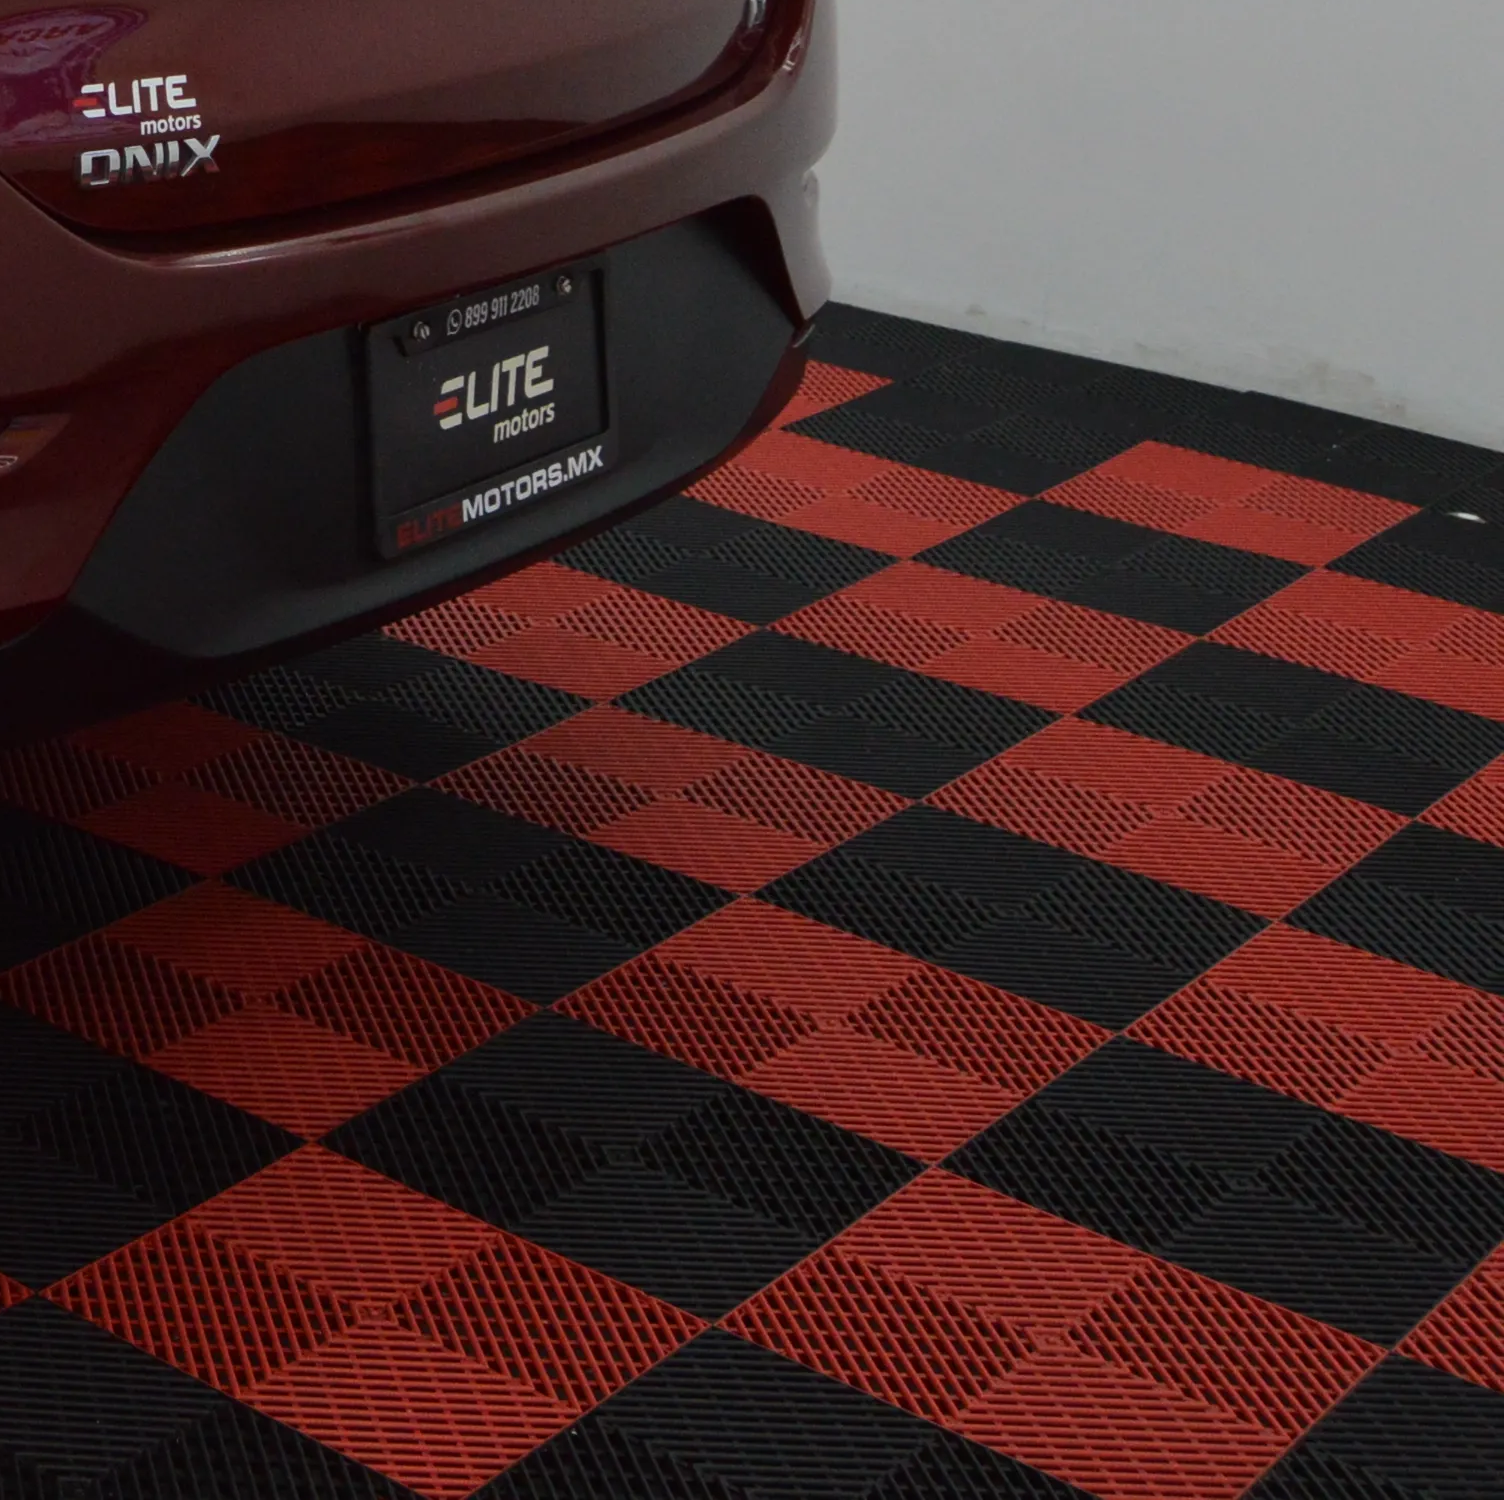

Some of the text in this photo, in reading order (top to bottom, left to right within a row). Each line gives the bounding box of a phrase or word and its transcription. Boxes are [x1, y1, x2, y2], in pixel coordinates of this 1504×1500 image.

[72, 74, 197, 119] ELITE
[140, 114, 202, 136] motors
[80, 134, 221, 187] ONIX
[465, 284, 540, 329] 899 911 2208
[433, 345, 555, 431] ELITE
[493, 402, 555, 444] motors
